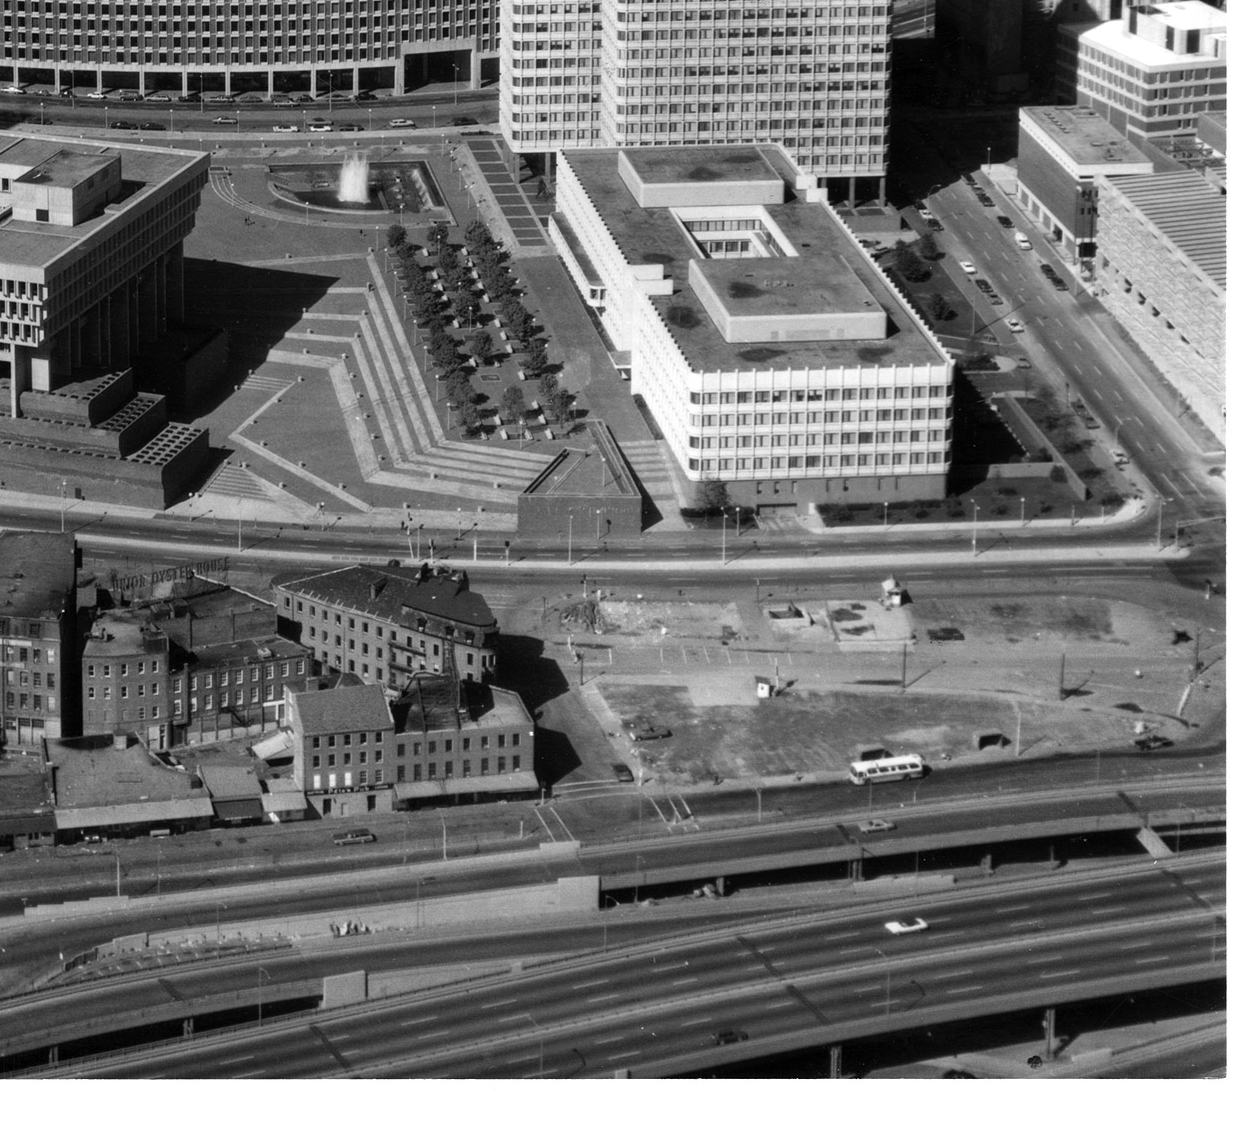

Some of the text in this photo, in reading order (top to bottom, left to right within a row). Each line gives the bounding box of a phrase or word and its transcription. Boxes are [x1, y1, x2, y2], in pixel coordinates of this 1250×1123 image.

[112, 556, 231, 592] UNION OYSTER HOUSE
